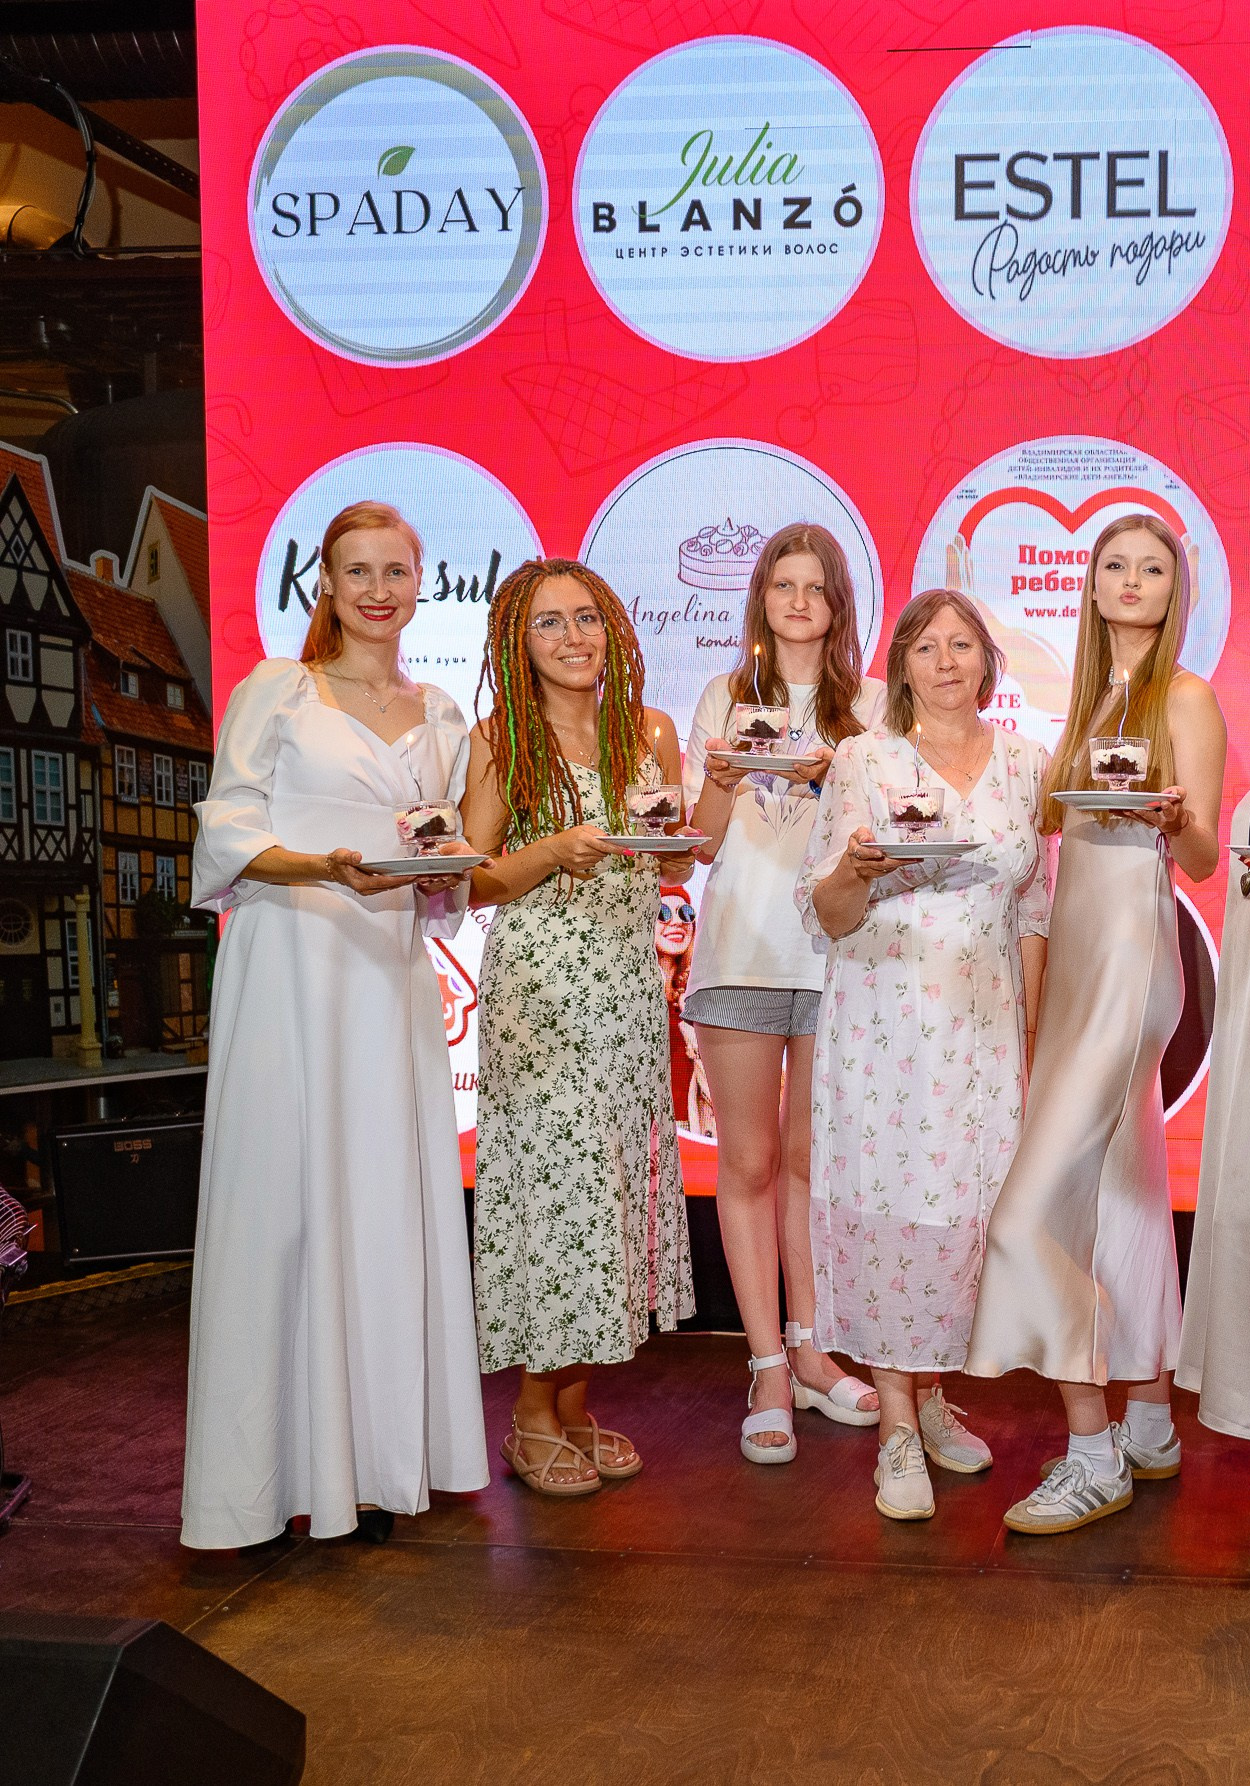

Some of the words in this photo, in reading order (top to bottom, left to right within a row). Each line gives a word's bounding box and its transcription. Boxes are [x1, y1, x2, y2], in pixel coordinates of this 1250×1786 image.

[631, 121, 805, 218] Julia
[954, 149, 1197, 222] ESTEL
[271, 186, 526, 238] SPADAY
[592, 182, 863, 233] BLANZÓ
[615, 247, 668, 260] ЦЕНТР
[680, 245, 772, 257] ЭСТЕТИКИ
[784, 243, 839, 255] ВОЛОС
[972, 219, 1100, 302] Радость
[1110, 230, 1206, 286] подари
[1018, 544, 1090, 565] Помо
[626, 593, 731, 635] Angelina
[1024, 605, 1079, 618] www.de
[696, 635, 740, 649] Kondi
[436, 656, 466, 666] души
[114, 1139, 152, 1152] BOSS
